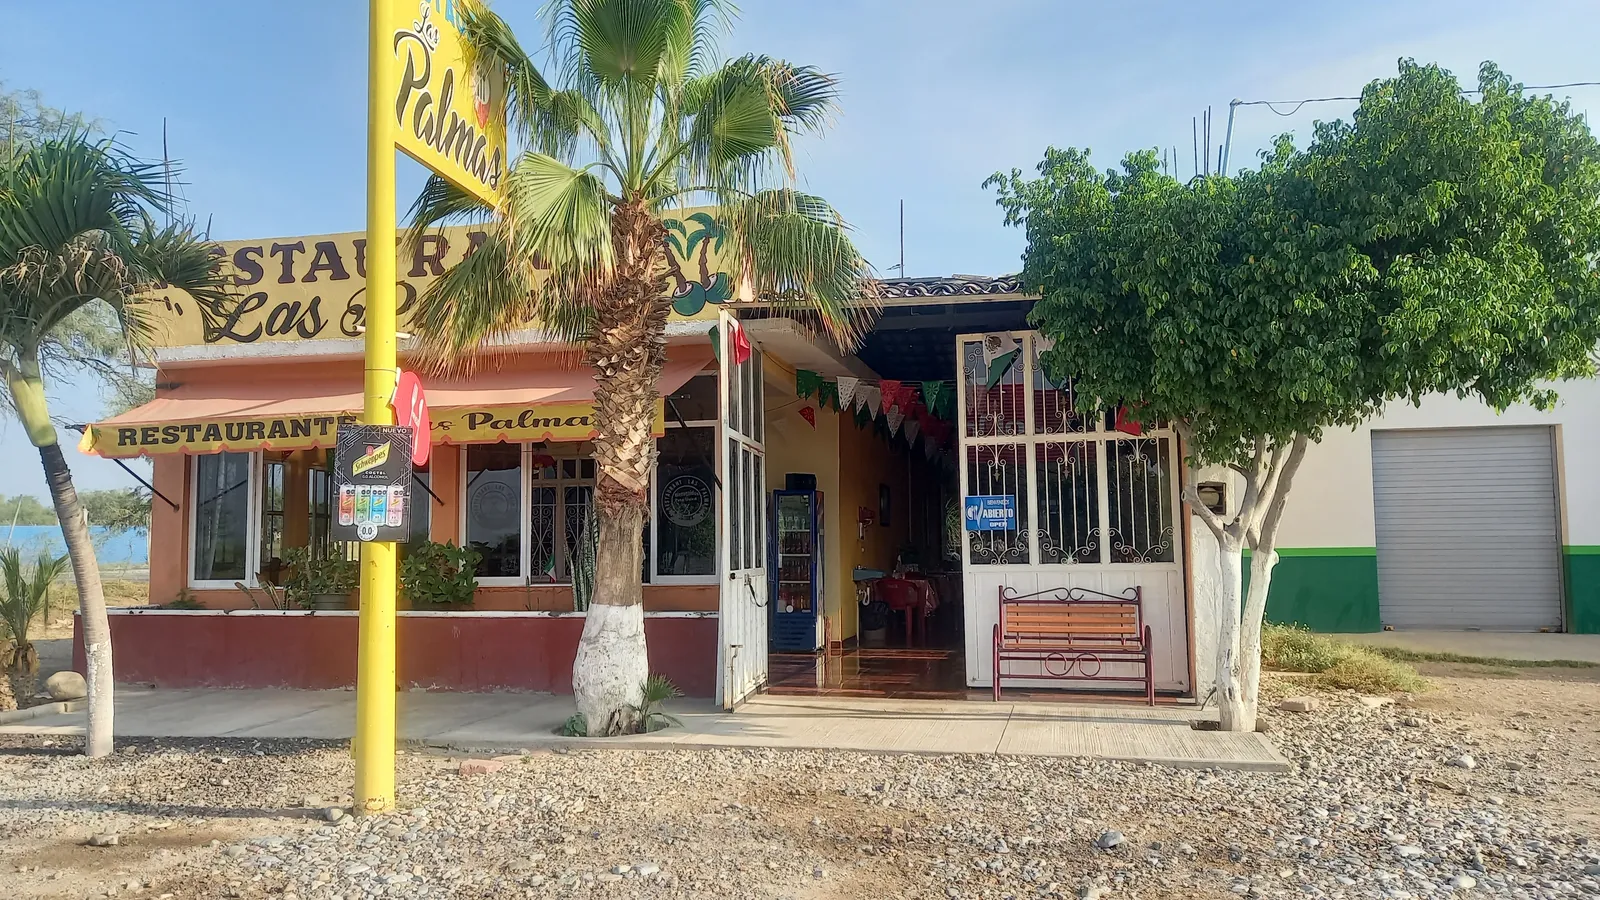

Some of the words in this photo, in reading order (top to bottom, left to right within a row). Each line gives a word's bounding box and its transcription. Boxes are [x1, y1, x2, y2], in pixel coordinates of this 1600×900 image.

[414, 3, 438, 51] Las
[394, 31, 502, 191] Palmas
[461, 410, 599, 430] Palma
[355, 450, 386, 472] Schweppes
[982, 508, 1014, 519] ABIERTO
[361, 526, 373, 535] 0.0
